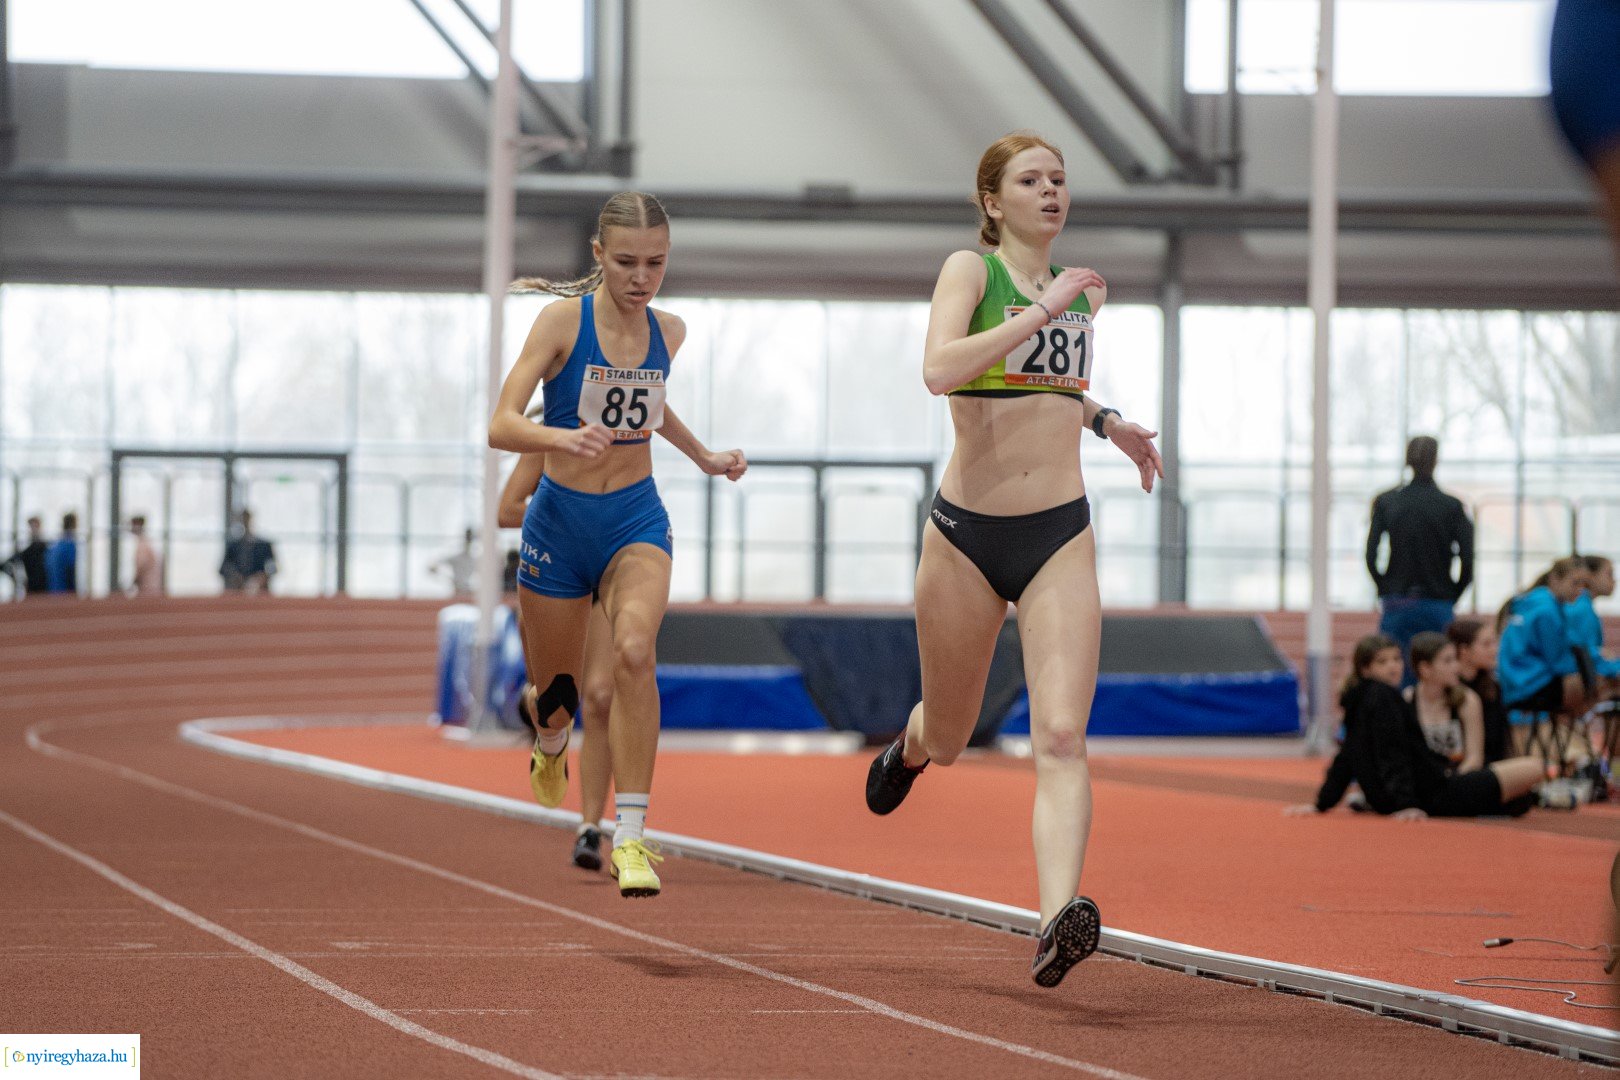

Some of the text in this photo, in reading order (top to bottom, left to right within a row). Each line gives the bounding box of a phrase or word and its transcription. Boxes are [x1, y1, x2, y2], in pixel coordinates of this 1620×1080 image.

[1052, 312, 1088, 324] ILITA
[1021, 328, 1086, 378] 281
[1026, 376, 1080, 388] ATLETIKA
[601, 387, 649, 430] 85
[616, 431, 644, 440] ETIKA
[932, 509, 957, 529] ATEX
